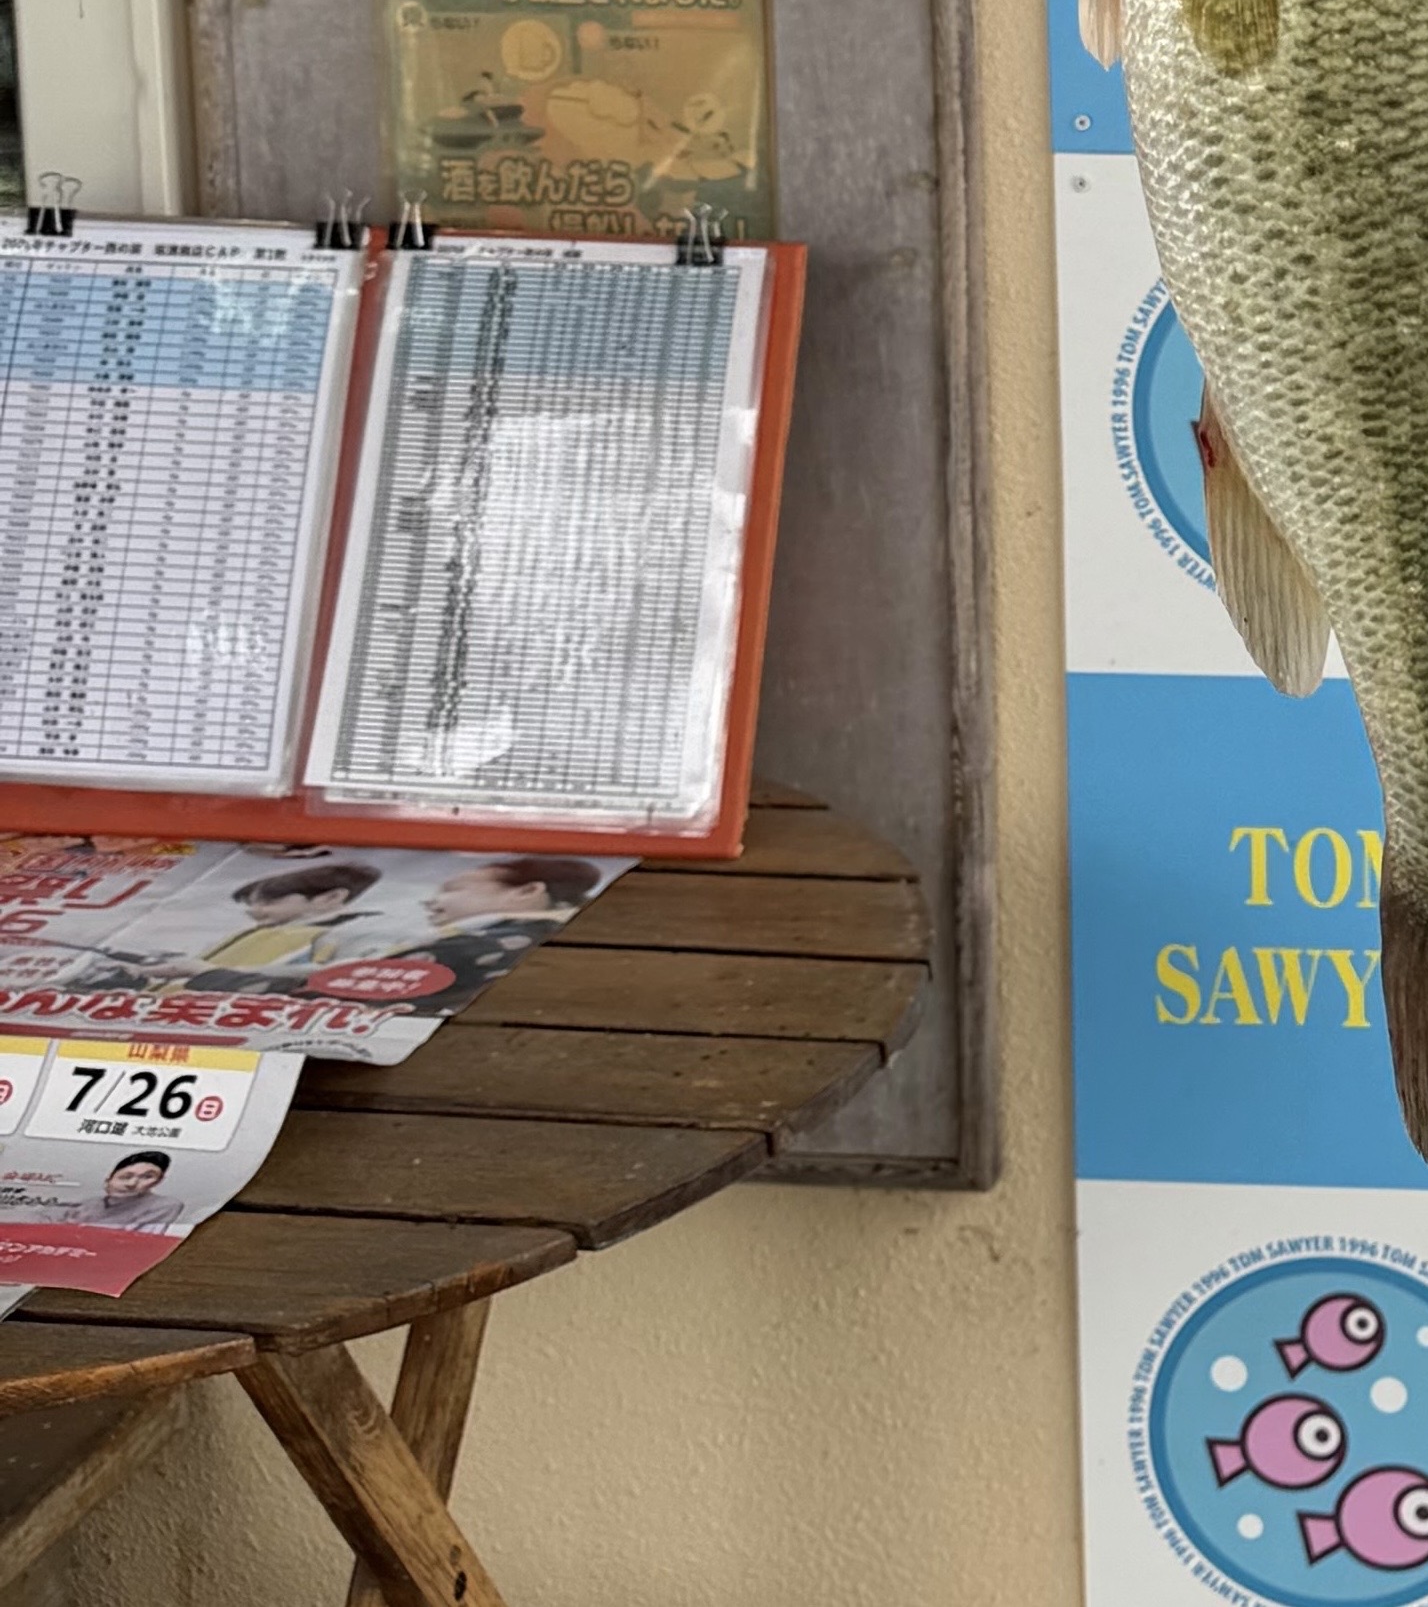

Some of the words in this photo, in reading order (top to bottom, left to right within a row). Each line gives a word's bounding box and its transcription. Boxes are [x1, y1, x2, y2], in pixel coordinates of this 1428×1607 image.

[439, 155, 635, 208] 酒を飲んだら
[1155, 943, 1382, 1028] SAWY
[127, 1042, 192, 1064] 山梨県
[65, 1065, 199, 1120] 7/26
[196, 1096, 223, 1121] 日
